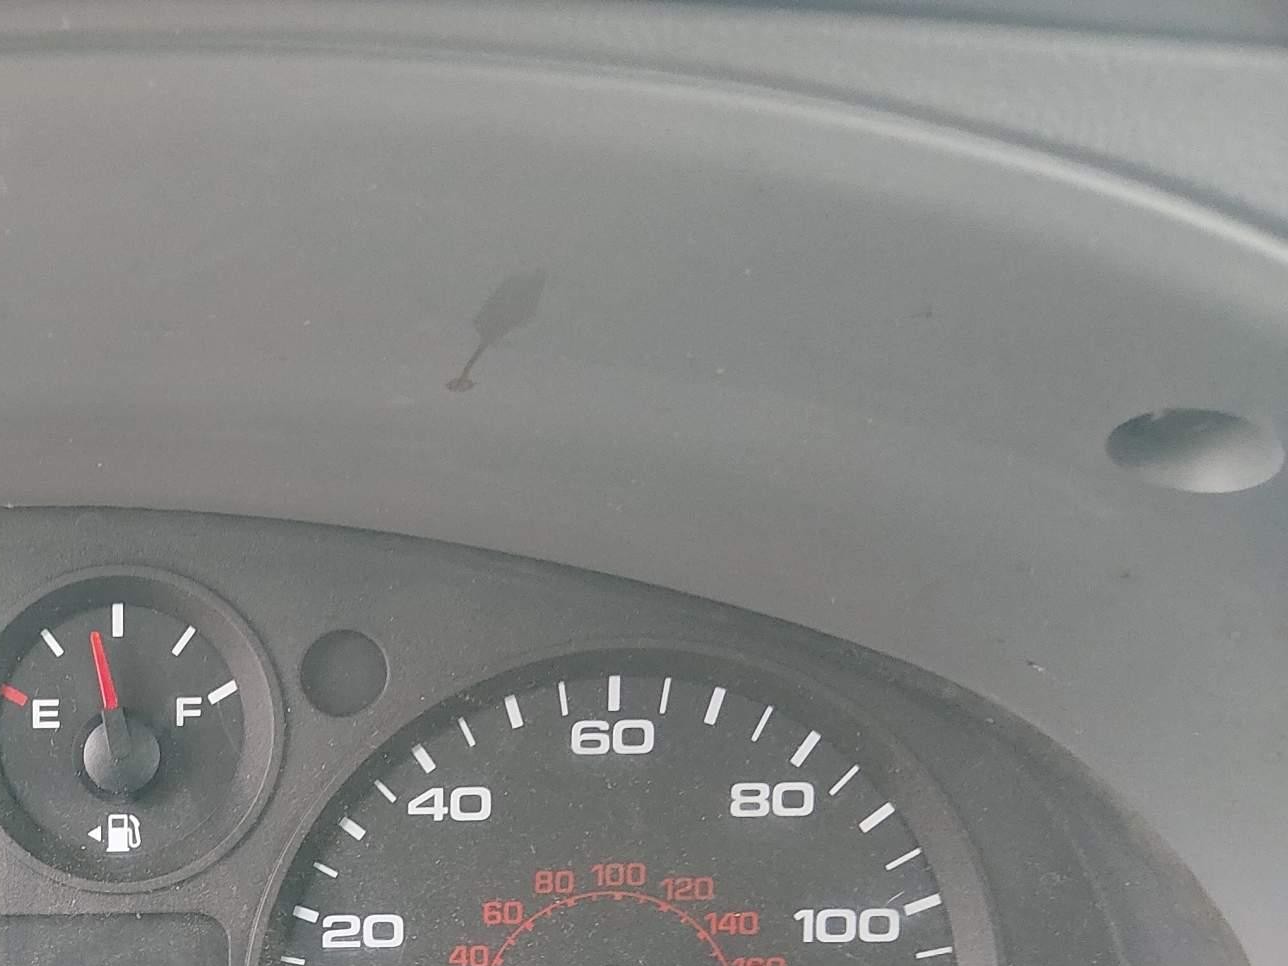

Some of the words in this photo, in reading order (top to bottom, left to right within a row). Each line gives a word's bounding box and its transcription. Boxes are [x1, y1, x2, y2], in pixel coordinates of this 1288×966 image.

[33, 700, 60, 728] E
[177, 697, 202, 726] F
[571, 720, 654, 754] 60
[408, 787, 491, 821] 40
[731, 782, 814, 817] 80
[535, 871, 574, 893] 80
[594, 864, 644, 884] 100
[664, 878, 714, 900] 120
[483, 902, 523, 924] 60
[707, 912, 759, 934] 140
[794, 909, 899, 942] 100
[323, 915, 403, 947] 20
